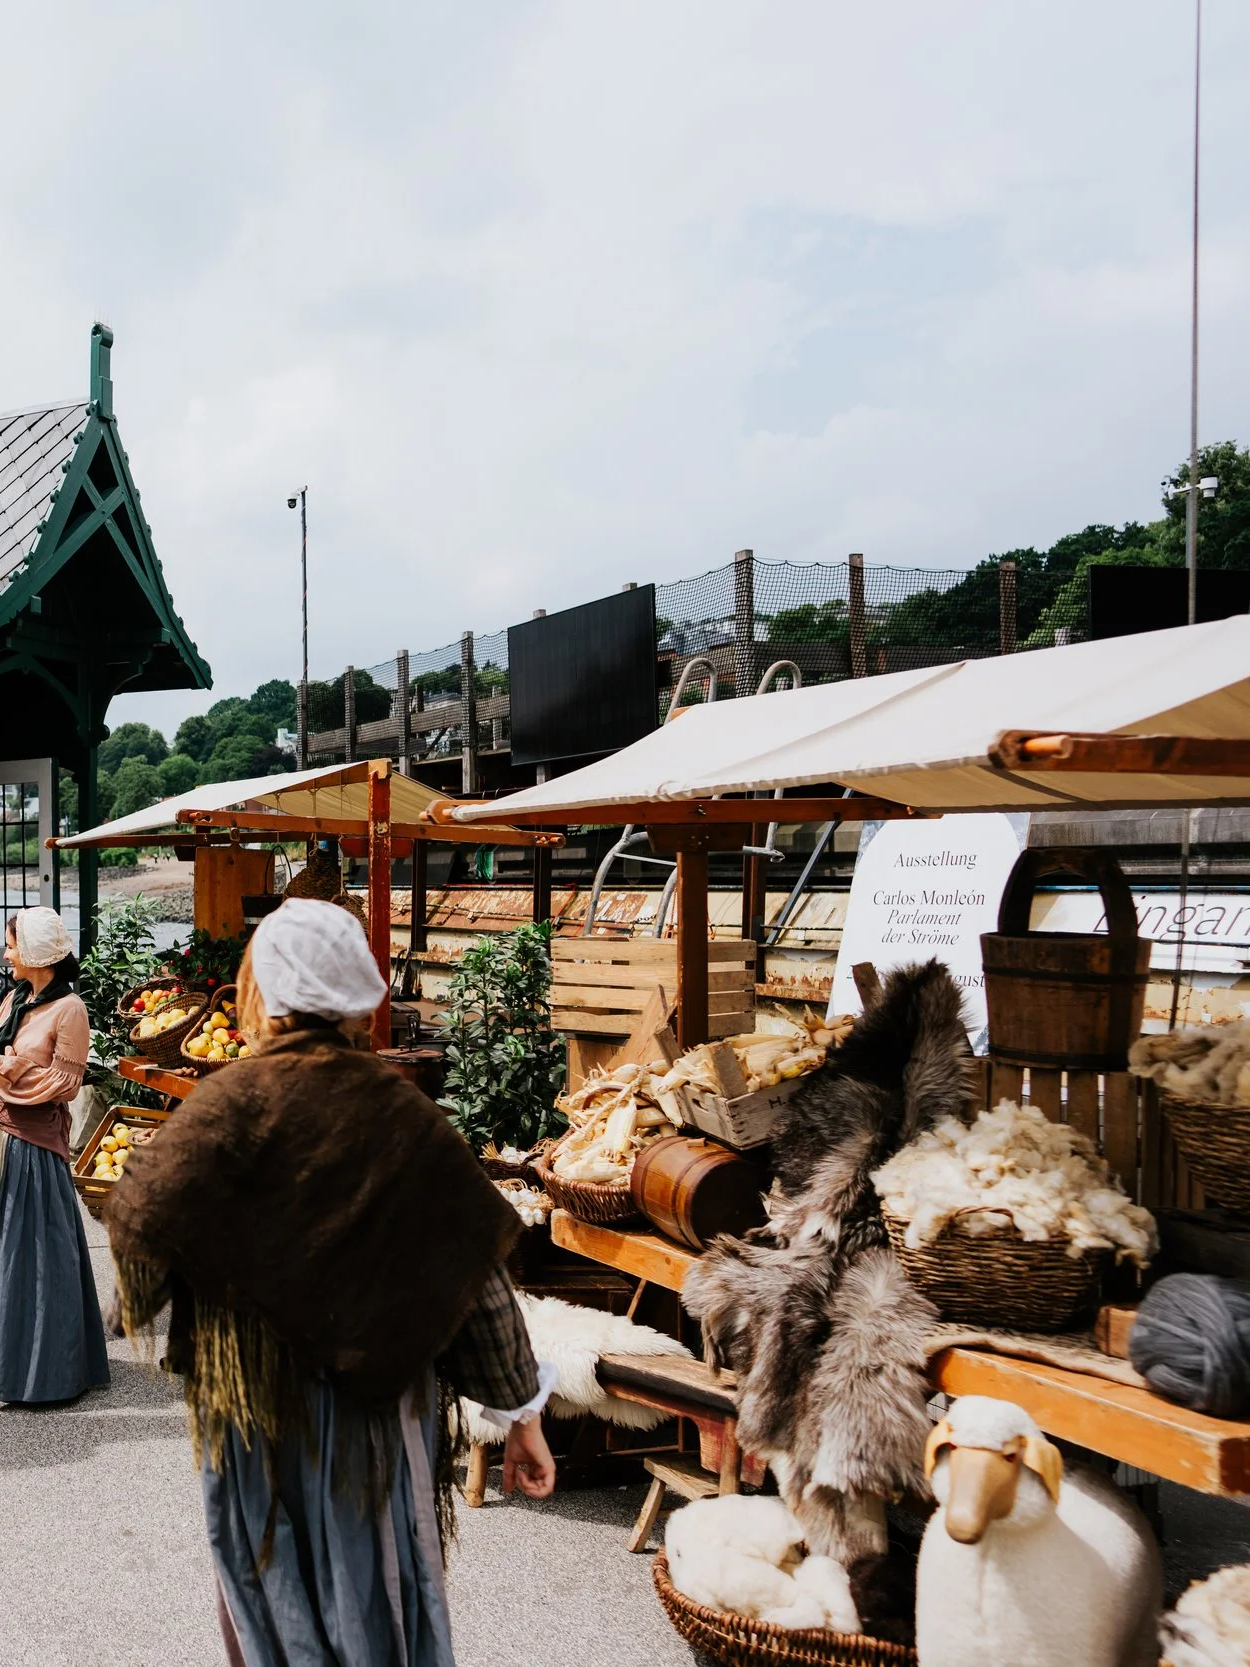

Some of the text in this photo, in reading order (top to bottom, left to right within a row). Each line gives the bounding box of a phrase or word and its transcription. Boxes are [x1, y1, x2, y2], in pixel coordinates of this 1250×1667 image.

[894, 851, 978, 870] Ausstellung
[873, 889, 986, 906] Carlos Monleón
[887, 909, 962, 925] Parlament
[881, 928, 960, 945] der Ströme
